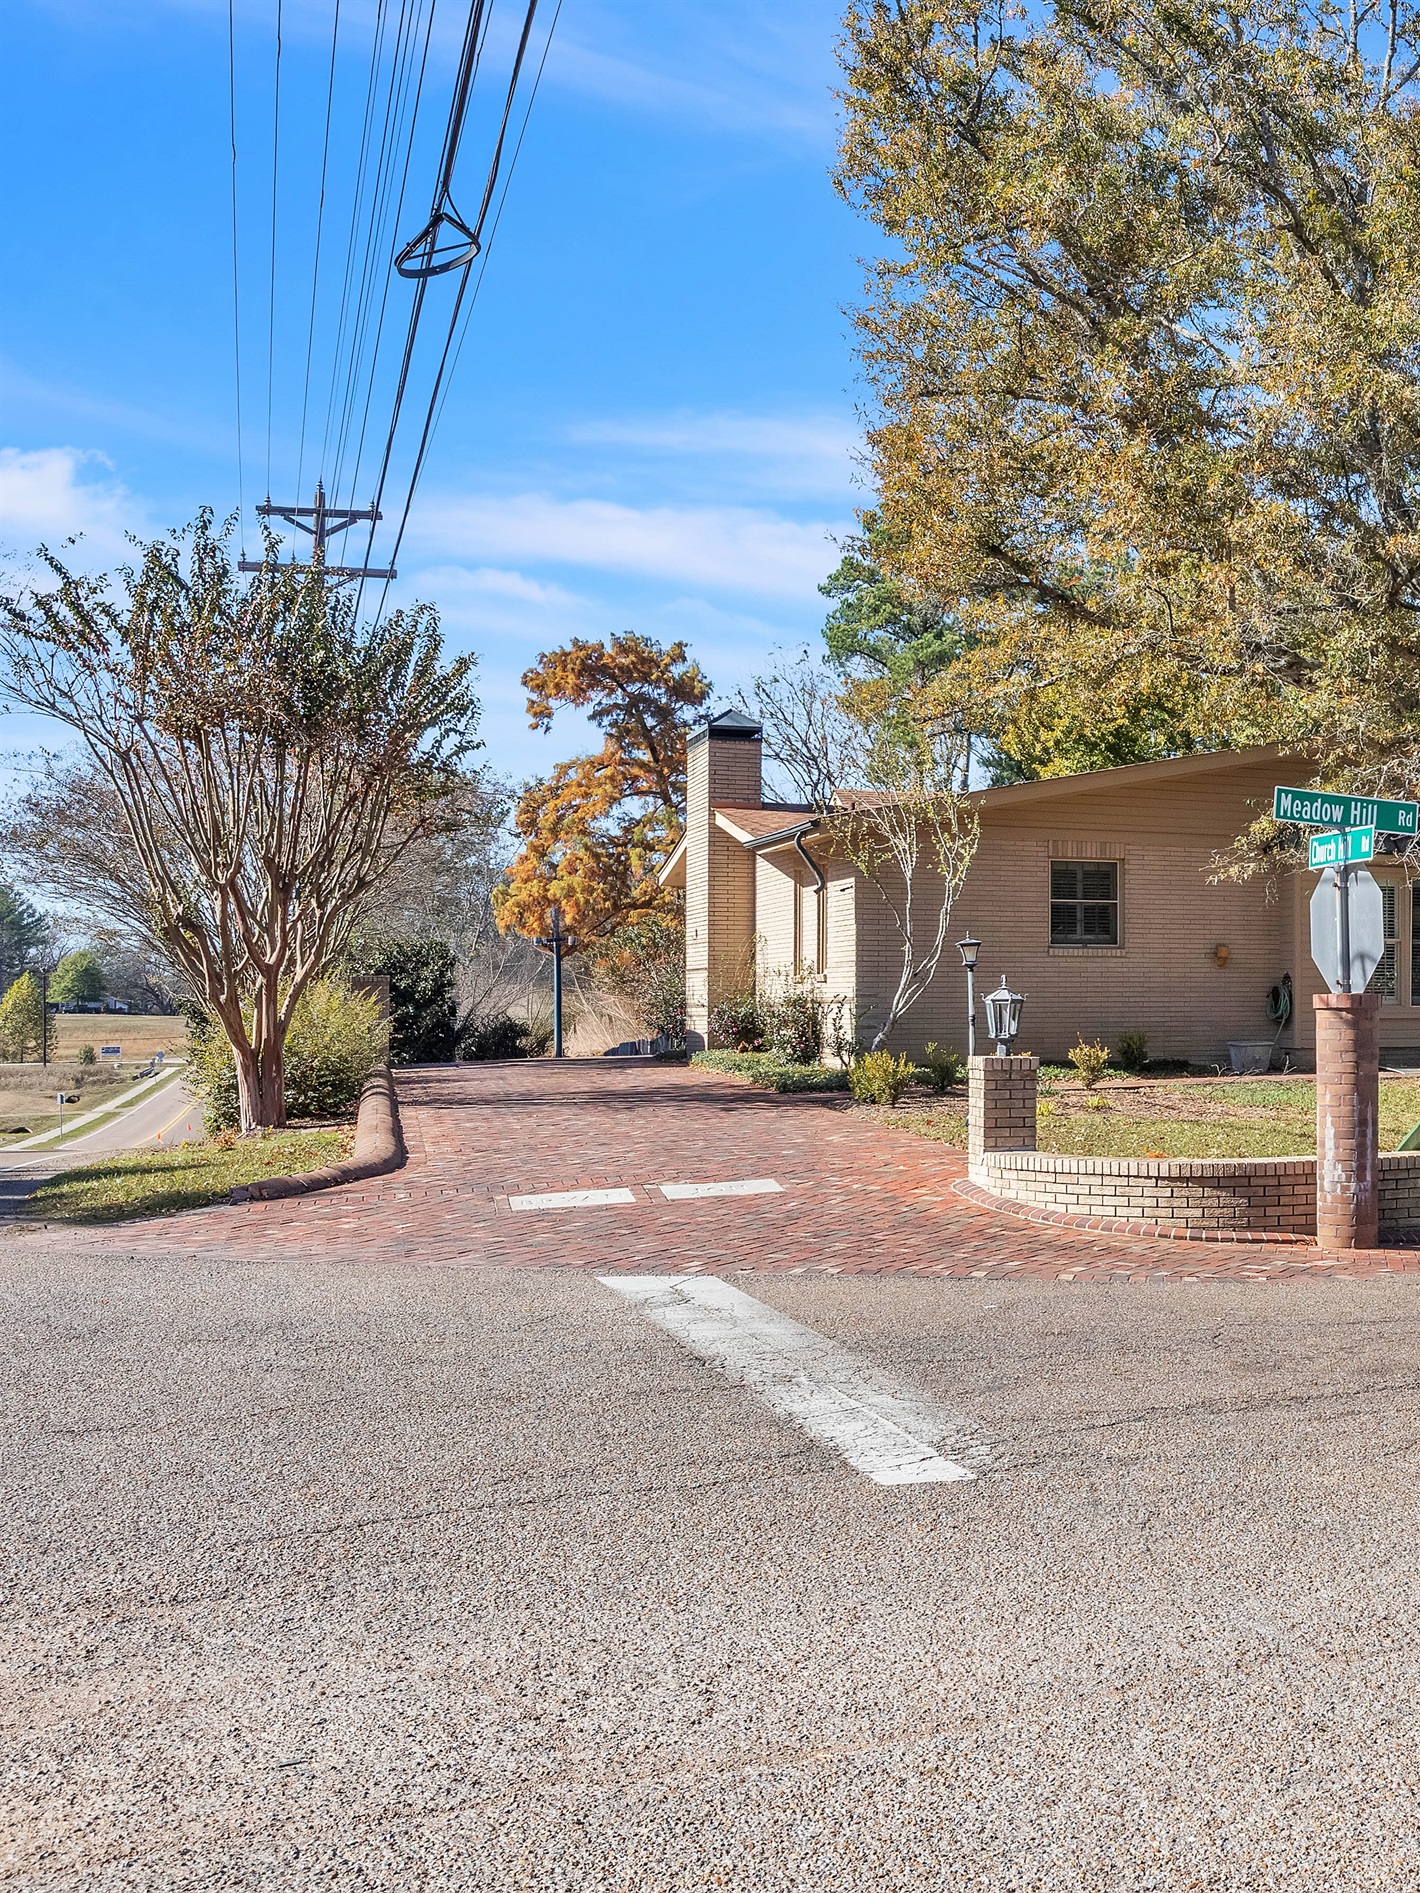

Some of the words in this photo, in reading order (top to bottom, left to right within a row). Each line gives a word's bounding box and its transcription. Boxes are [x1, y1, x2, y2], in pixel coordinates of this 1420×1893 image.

[1280, 793, 1344, 822] Meadow
[1350, 801, 1378, 827] Hill
[1398, 810, 1413, 827] Rd
[1312, 838, 1336, 864] Church
[1361, 835, 1370, 853] Rd
